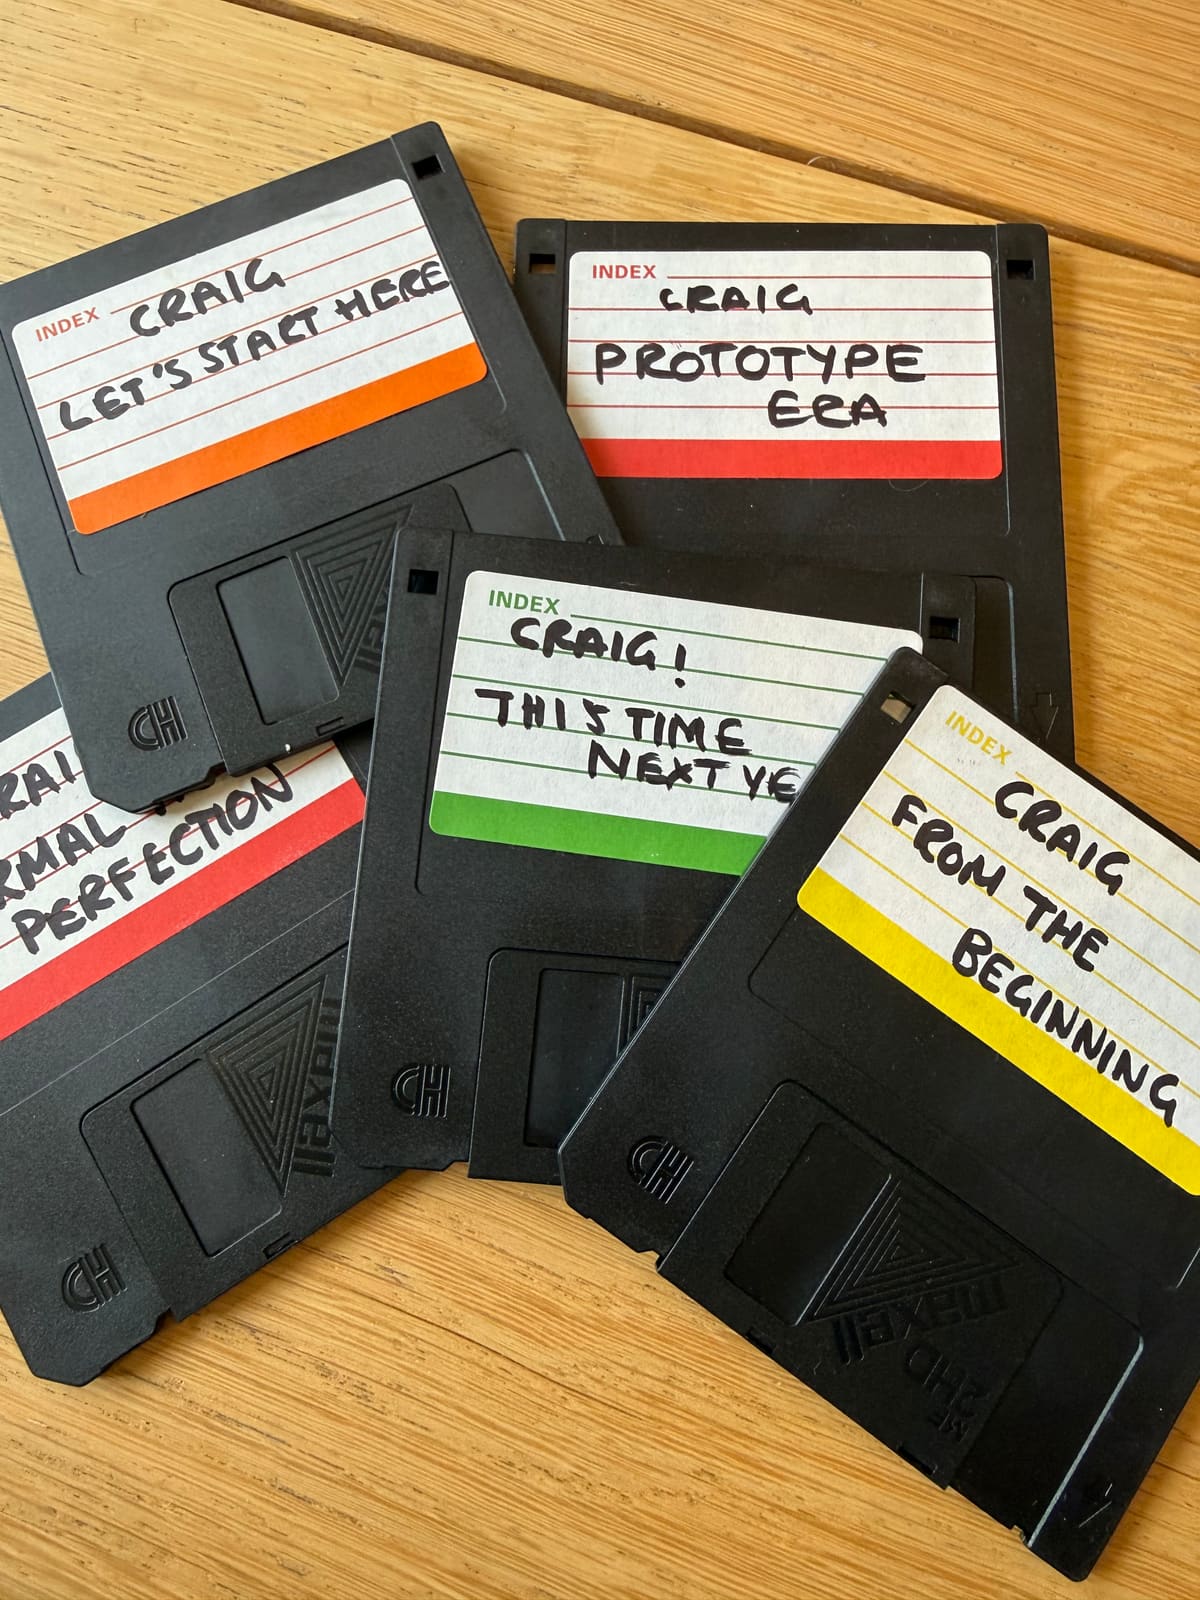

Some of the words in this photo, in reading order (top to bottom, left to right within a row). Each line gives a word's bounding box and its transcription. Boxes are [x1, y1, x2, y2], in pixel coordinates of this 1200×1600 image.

[130, 259, 286, 336] CRAIG
[592, 264, 656, 279] INDEX
[659, 284, 812, 315] CRAIG
[35, 308, 101, 342] INDEX
[60, 359, 192, 431] LET'S
[199, 306, 318, 373] START
[335, 261, 450, 322] HERE
[595, 342, 926, 385] PROTOTYPE
[768, 390, 888, 428] ERA
[489, 589, 560, 615] INDEX
[475, 688, 610, 735] THIS
[625, 707, 752, 756] TIME
[945, 709, 1013, 766] INDEX
[587, 740, 731, 791] NEXT
[11, 763, 294, 954] PERFECTION
[995, 781, 1131, 896] CRAIG
[892, 795, 1006, 896] FROM
[1023, 885, 1109, 973] THE
[952, 928, 1180, 1128] BEGINNING
